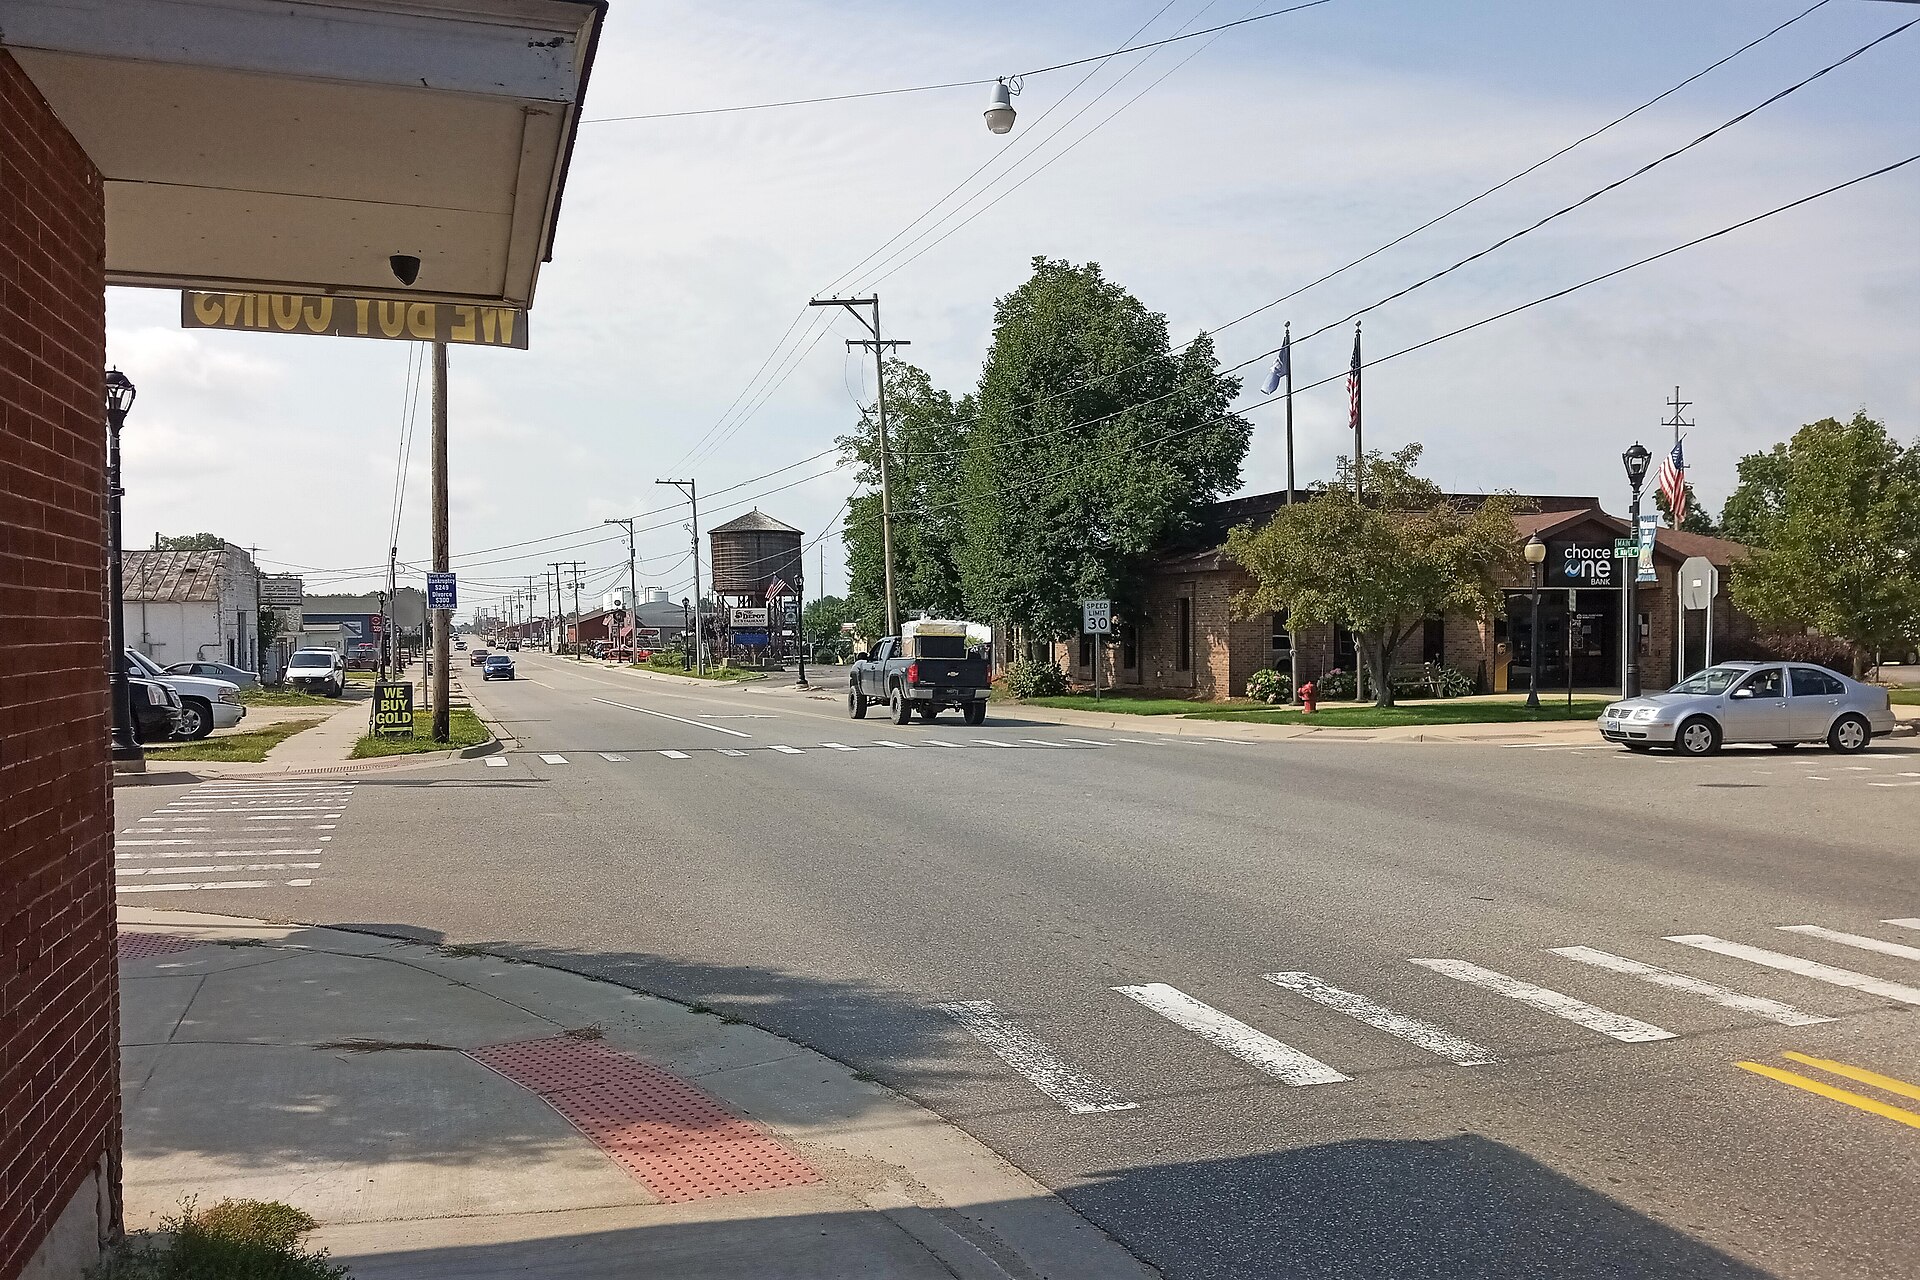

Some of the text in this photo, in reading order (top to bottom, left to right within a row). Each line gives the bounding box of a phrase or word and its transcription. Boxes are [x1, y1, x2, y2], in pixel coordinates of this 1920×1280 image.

[1590, 578, 1611, 586] BANK
[1087, 617, 1108, 630] 30
[383, 687, 405, 698] WE
[380, 699, 409, 711] BUY
[375, 712, 412, 724] GOLD
